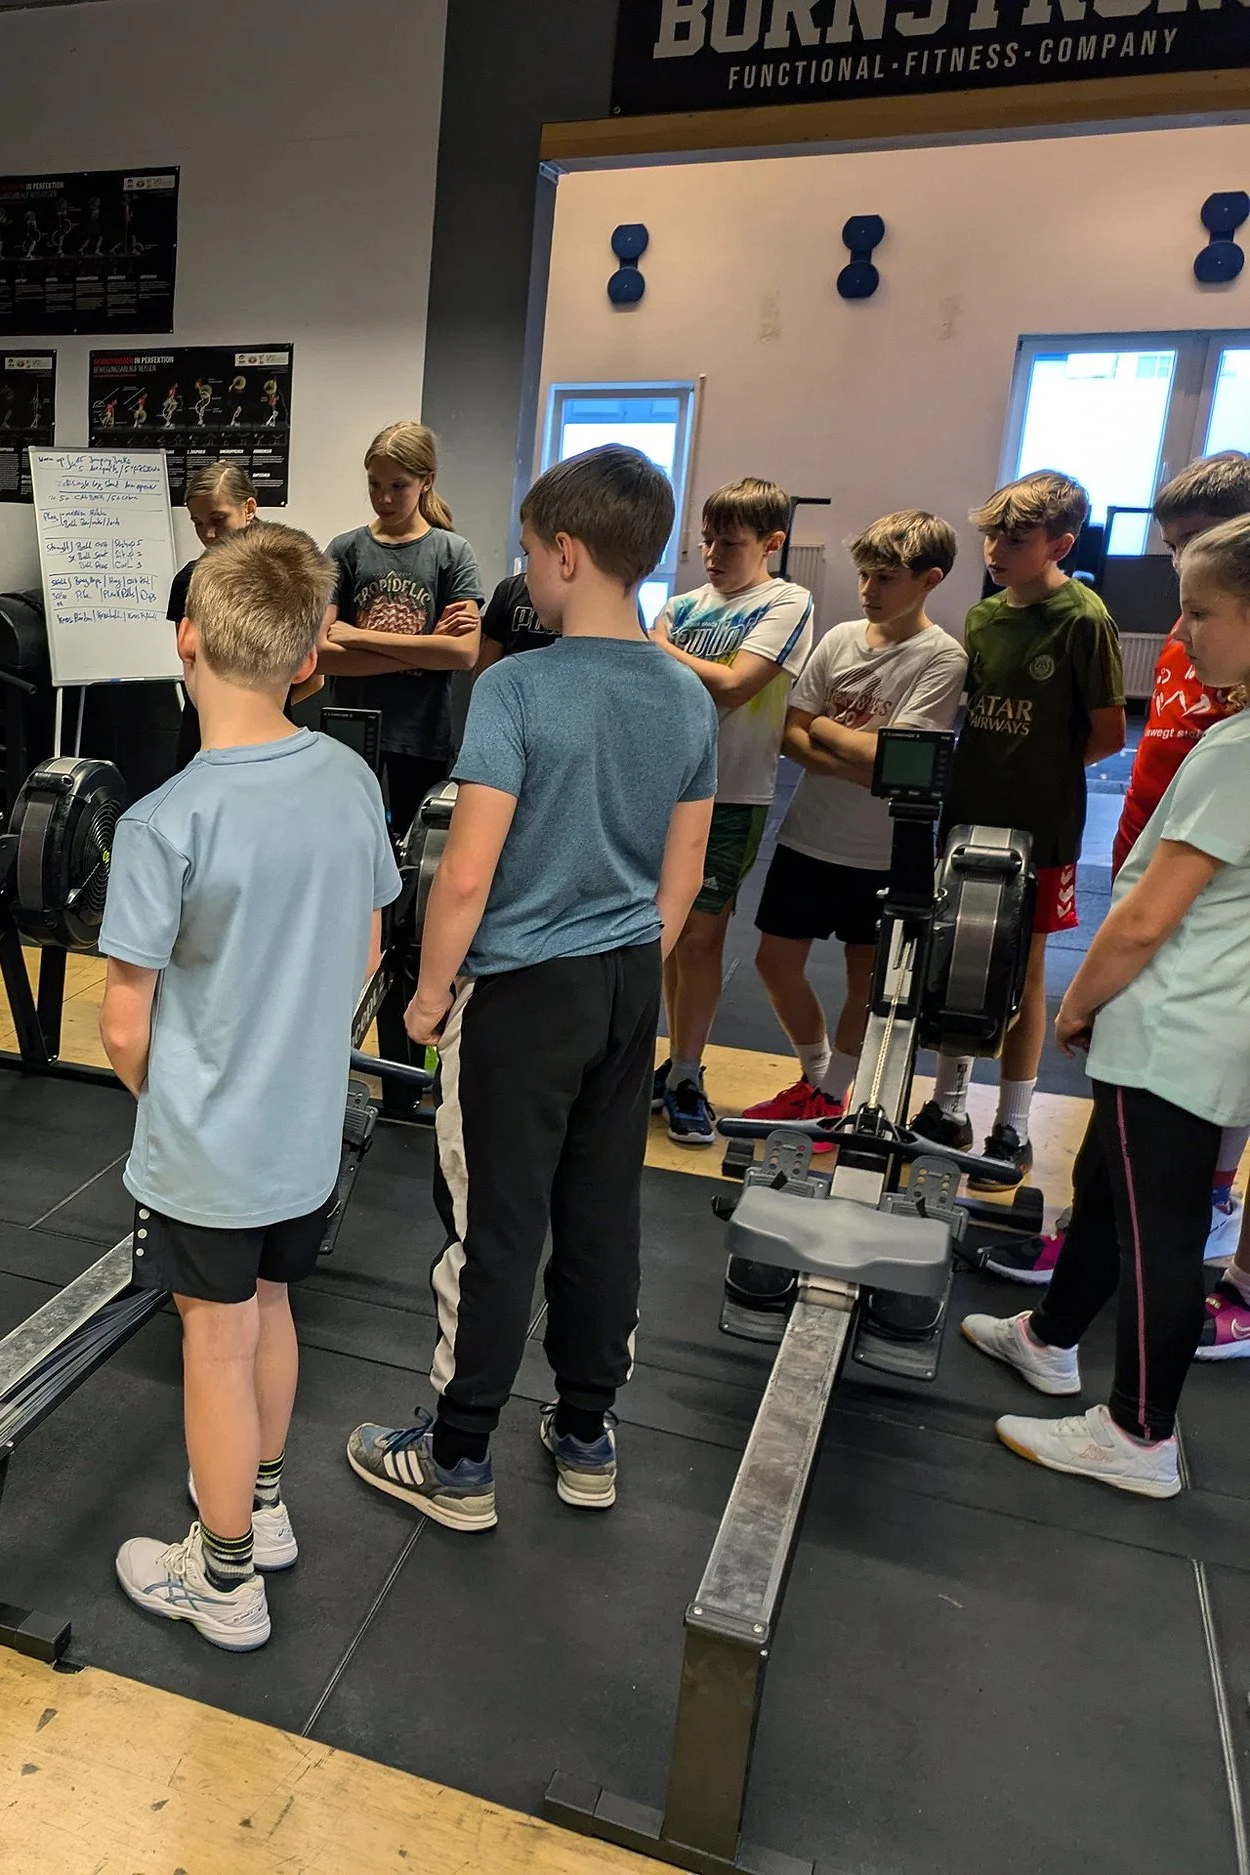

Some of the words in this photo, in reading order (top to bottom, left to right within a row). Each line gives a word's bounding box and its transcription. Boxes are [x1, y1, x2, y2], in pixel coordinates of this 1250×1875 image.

[728, 54, 884, 91] FUNCTIONAL
[904, 41, 1019, 76] FITNESS
[1038, 27, 1178, 65] COMPANY
